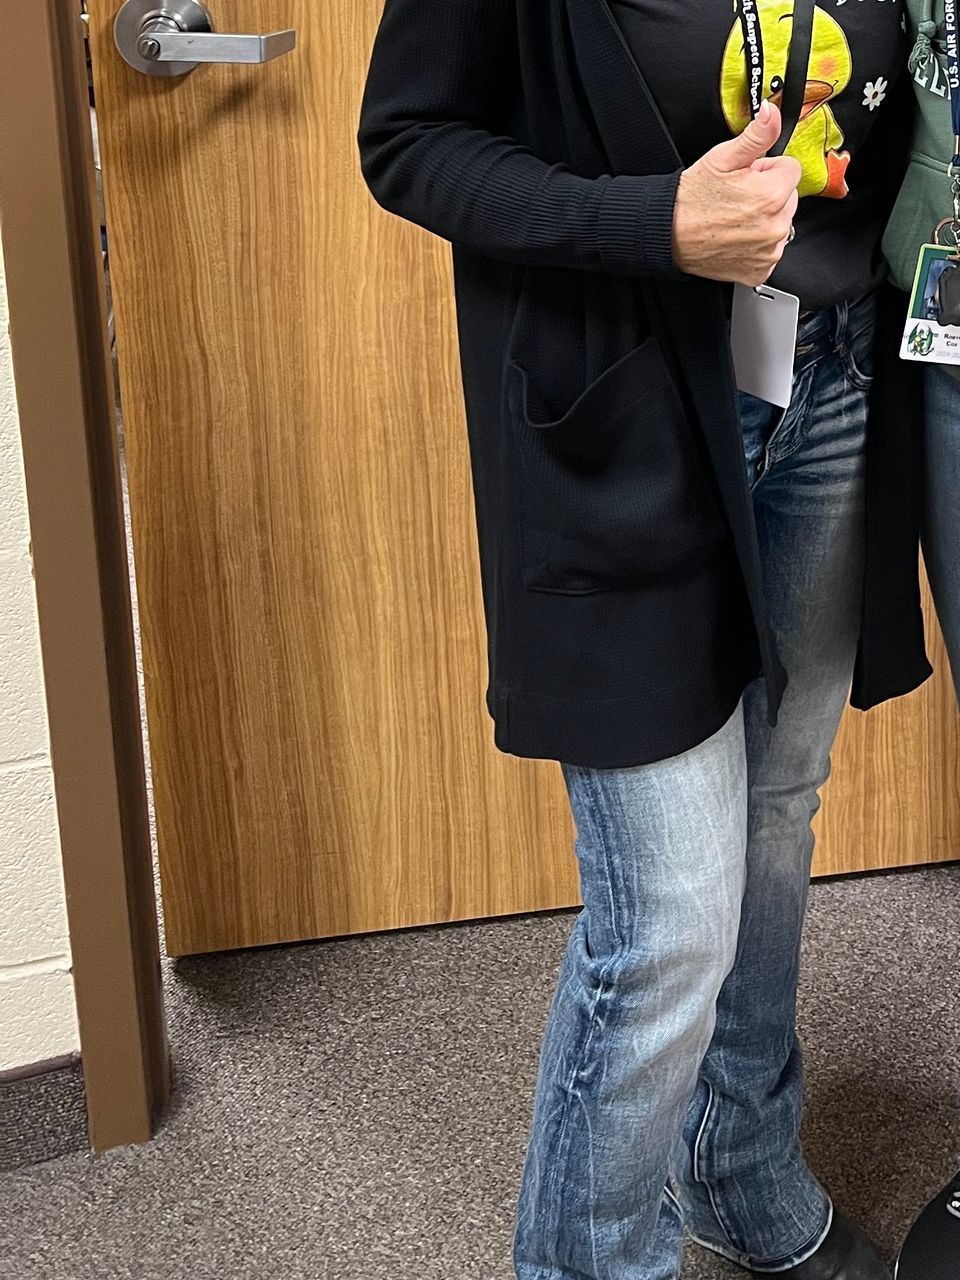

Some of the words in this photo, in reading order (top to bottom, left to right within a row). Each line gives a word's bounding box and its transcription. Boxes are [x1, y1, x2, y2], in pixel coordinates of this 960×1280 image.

[745, 12, 760, 65] Sanpete
[947, 33, 957, 58] AIR
[750, 66, 762, 111] School
[949, 61, 960, 89] U.S.
